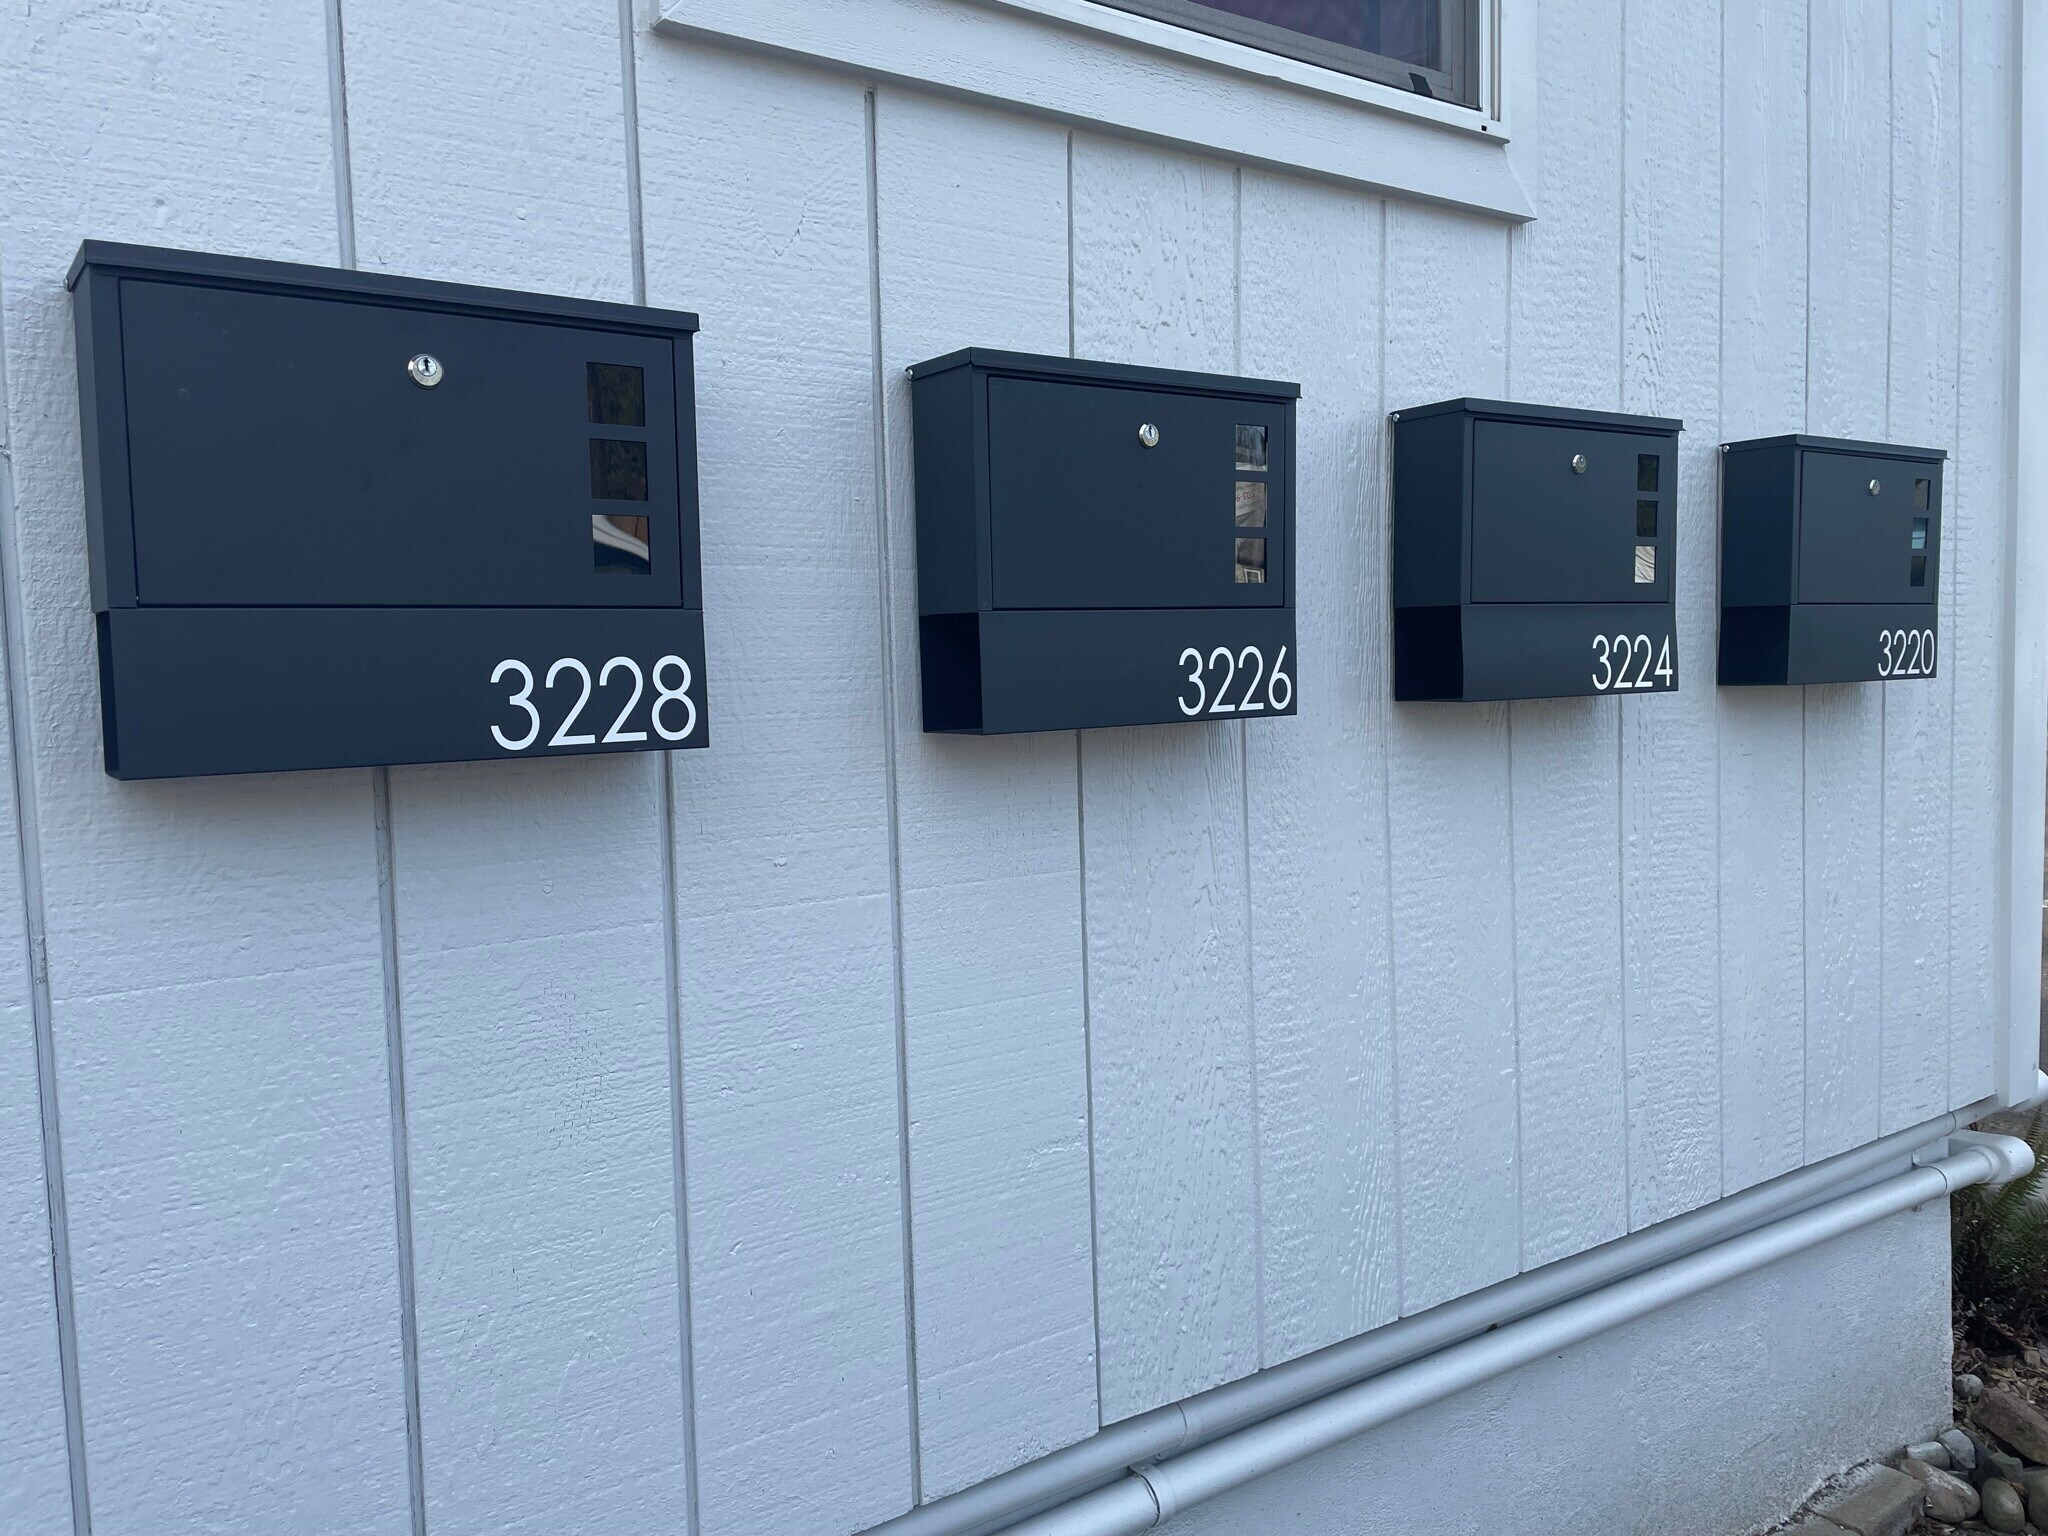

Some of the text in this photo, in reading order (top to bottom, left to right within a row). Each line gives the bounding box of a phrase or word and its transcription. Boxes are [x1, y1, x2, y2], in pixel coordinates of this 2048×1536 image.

[1178, 645, 1292, 716] 3226
[1592, 634, 1674, 691] 3224
[1877, 629, 1935, 677] 3220
[490, 654, 697, 751] 3228
